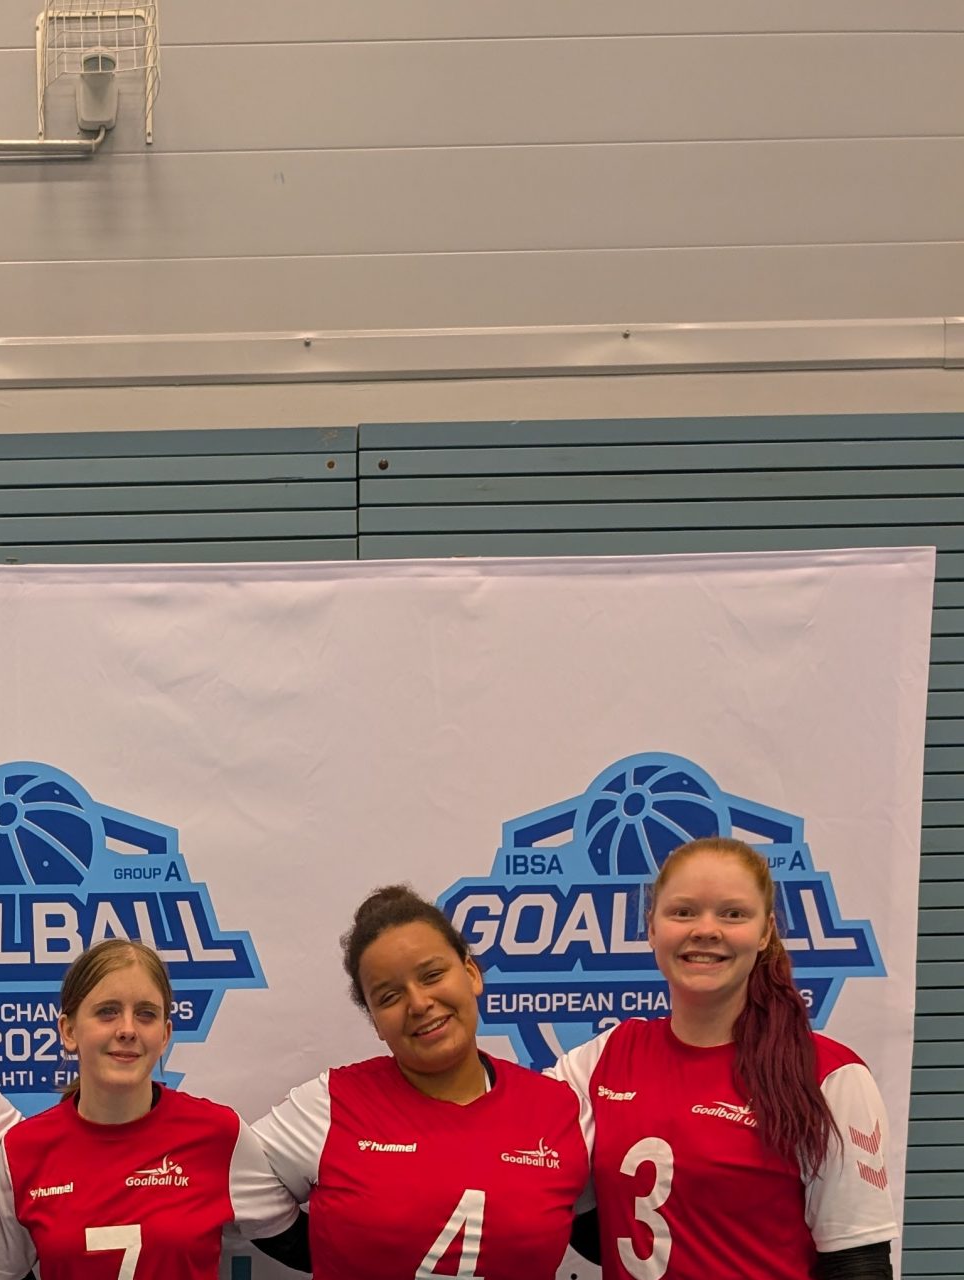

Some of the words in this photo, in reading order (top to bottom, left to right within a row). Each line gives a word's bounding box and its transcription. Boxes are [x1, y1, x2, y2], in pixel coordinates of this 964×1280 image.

[113, 867, 162, 881] GROUP
[164, 861, 182, 882] A
[505, 855, 564, 875] IBSA
[486, 992, 614, 1013] EUROPEAN
[691, 1104, 743, 1122] Goalball
[371, 1140, 417, 1153] hummel
[501, 1152, 544, 1167] Goalball
[546, 1158, 560, 1169] UK
[37, 1182, 73, 1197] hummel
[125, 1175, 172, 1187] Goalball
[174, 1176, 189, 1187] UK
